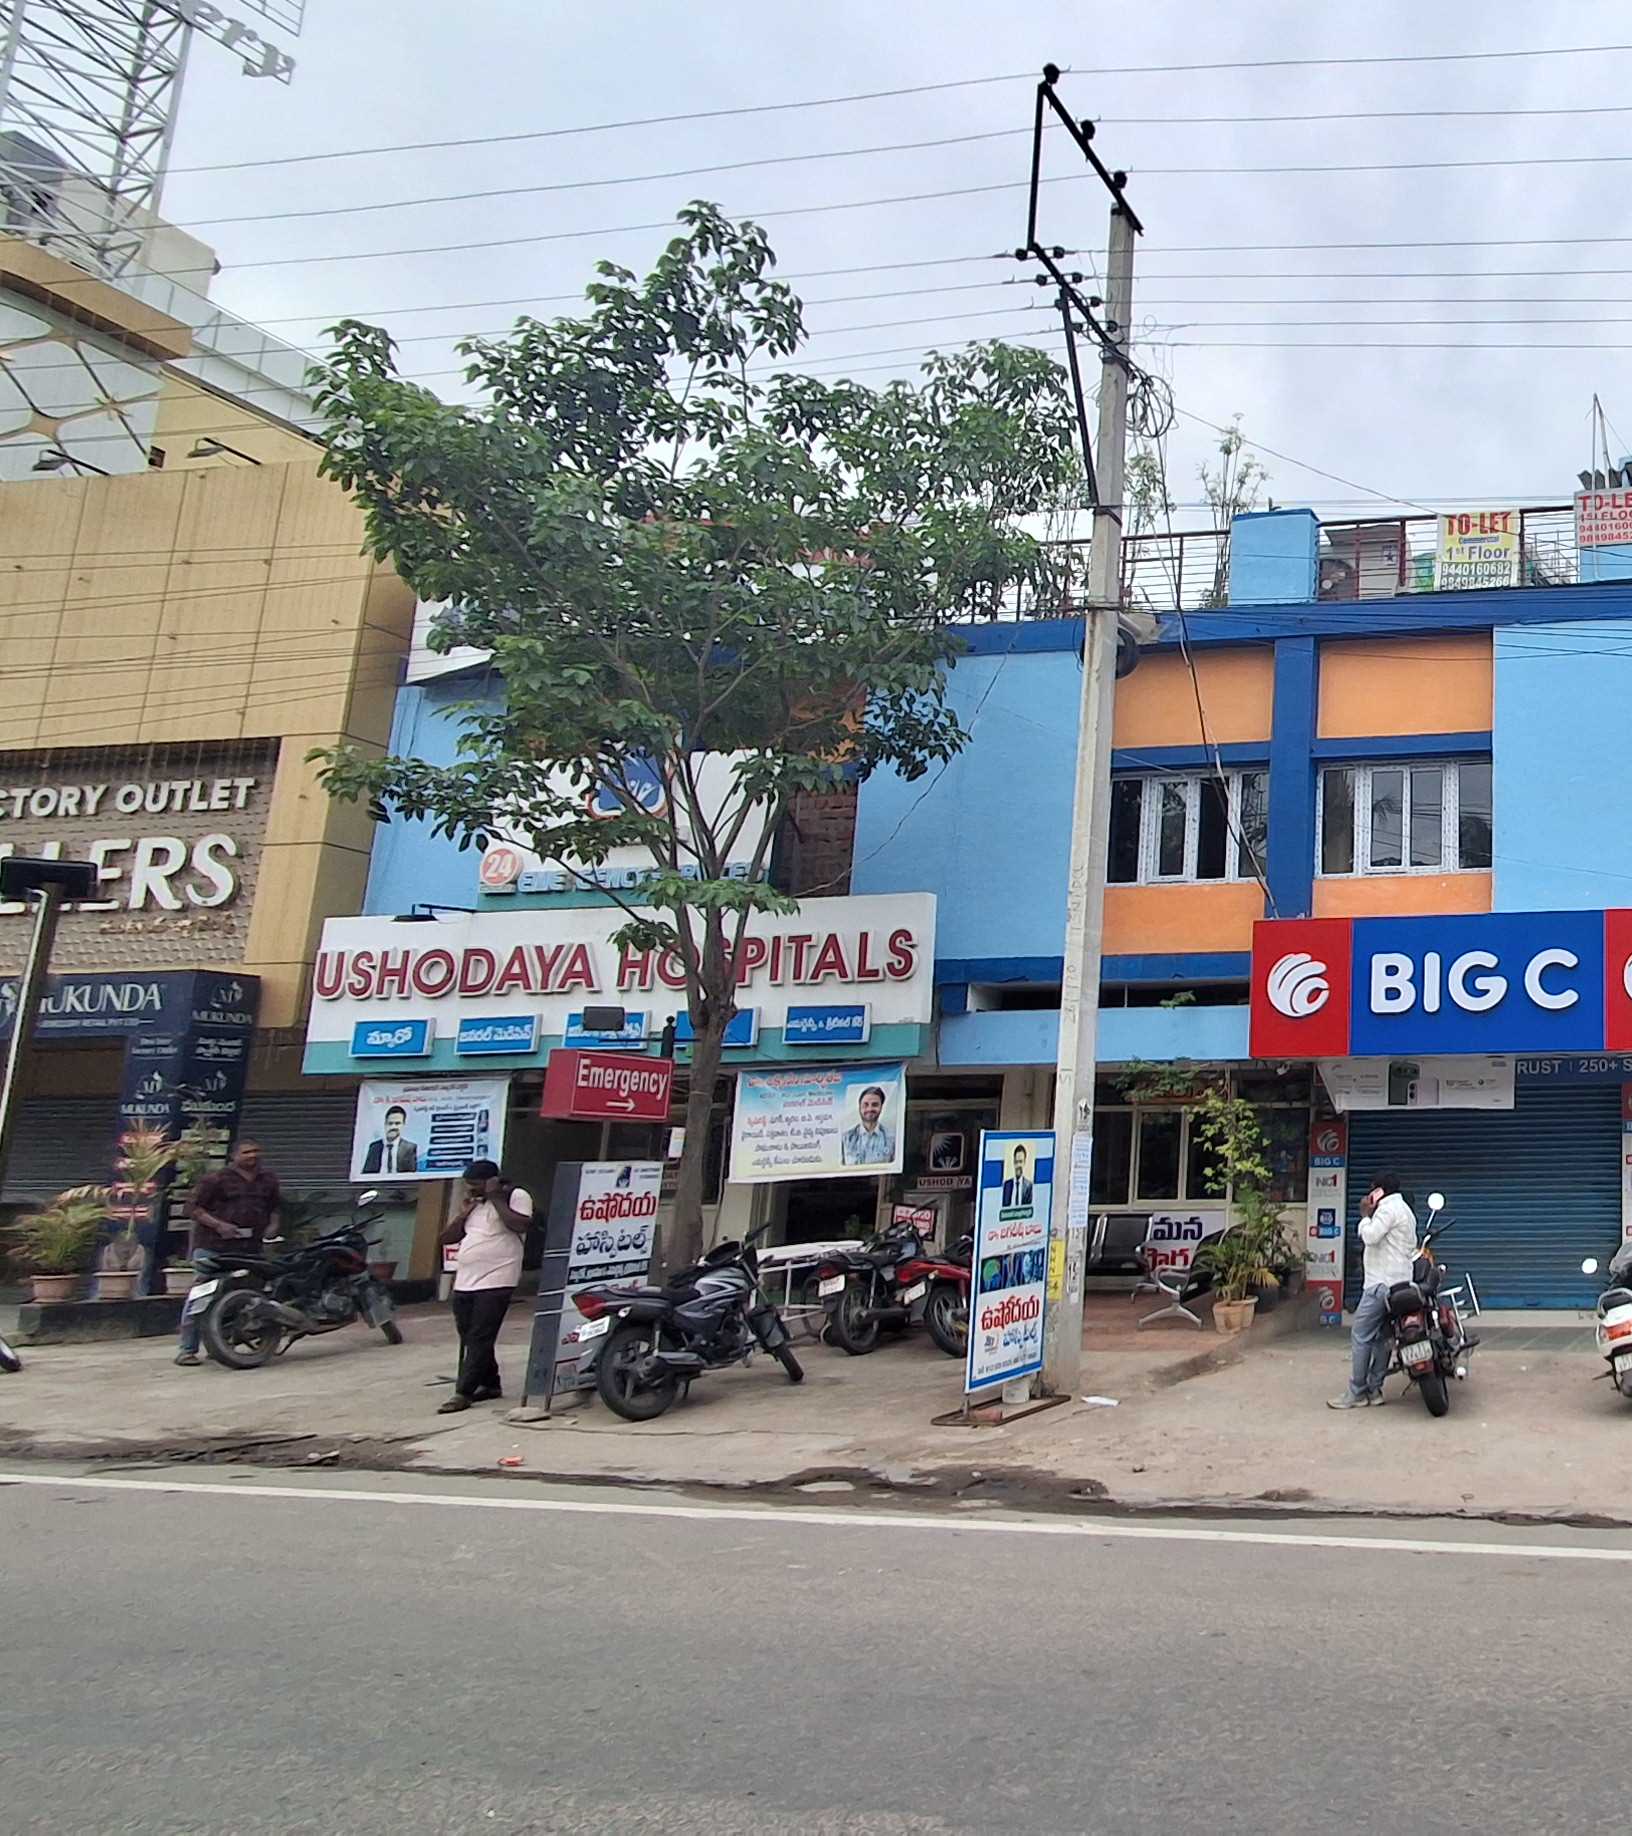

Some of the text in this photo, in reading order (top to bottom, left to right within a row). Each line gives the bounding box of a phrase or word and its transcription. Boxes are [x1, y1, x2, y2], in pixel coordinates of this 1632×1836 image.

[1447, 512, 1511, 536] TO-LET
[1468, 546, 1510, 560] Floor
[115, 778, 255, 814] OUTLET
[488, 852, 513, 880] 24
[315, 944, 599, 1000] USHODAYA
[1371, 948, 1579, 1014] BIG C
[577, 1058, 668, 1103] Emergency
[1517, 1059, 1562, 1076] RUST
[1579, 1058, 1618, 1075] 250+
[1314, 1156, 1340, 1167] BIG C
[919, 1178, 970, 1186] USHODYA
[579, 1191, 656, 1223] ఉషోదయ
[1153, 1216, 1203, 1241] మన
[981, 1296, 1039, 1332] ఉషోదయ
